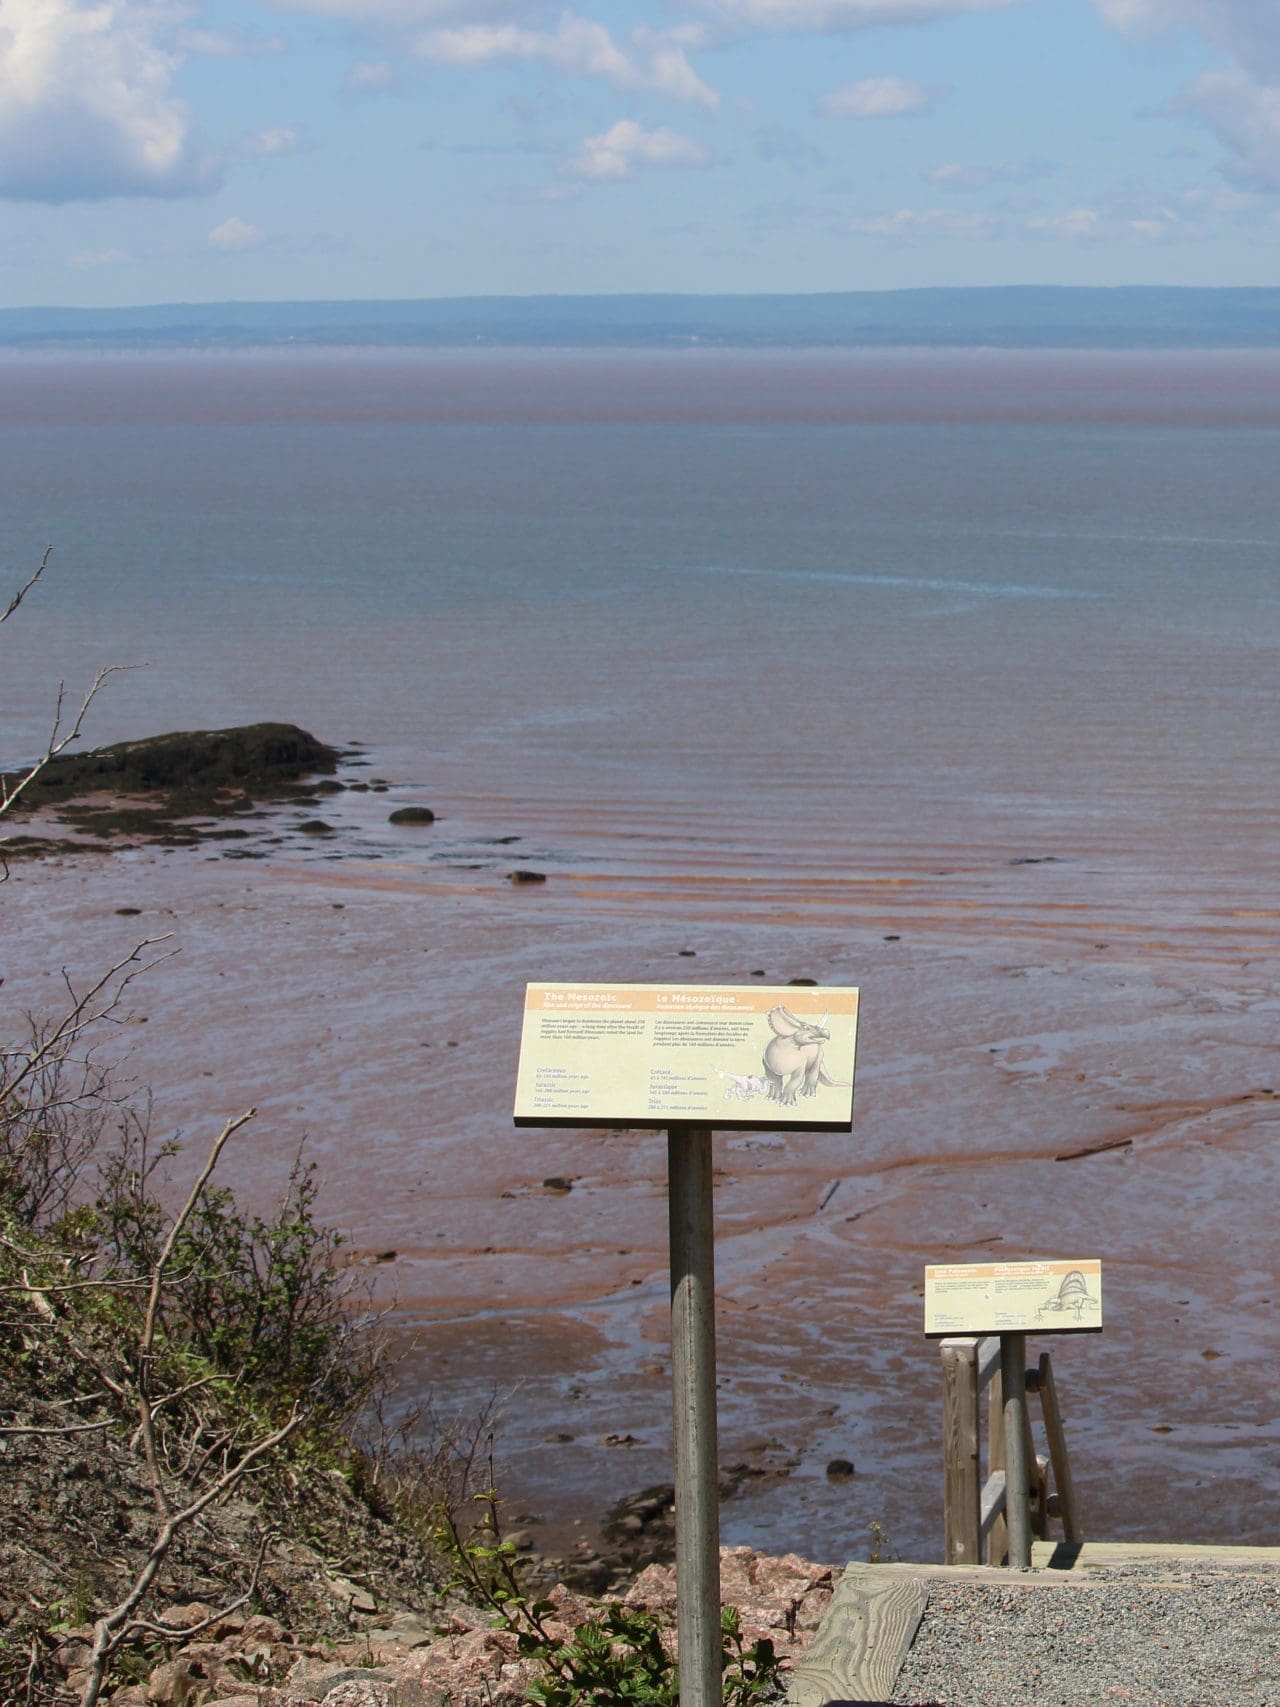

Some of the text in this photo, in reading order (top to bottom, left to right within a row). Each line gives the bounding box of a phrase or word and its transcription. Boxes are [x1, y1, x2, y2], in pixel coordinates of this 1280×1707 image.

[543, 992, 616, 1002] The Mesozoic
[656, 994, 736, 1004] Le Mésozoïque
